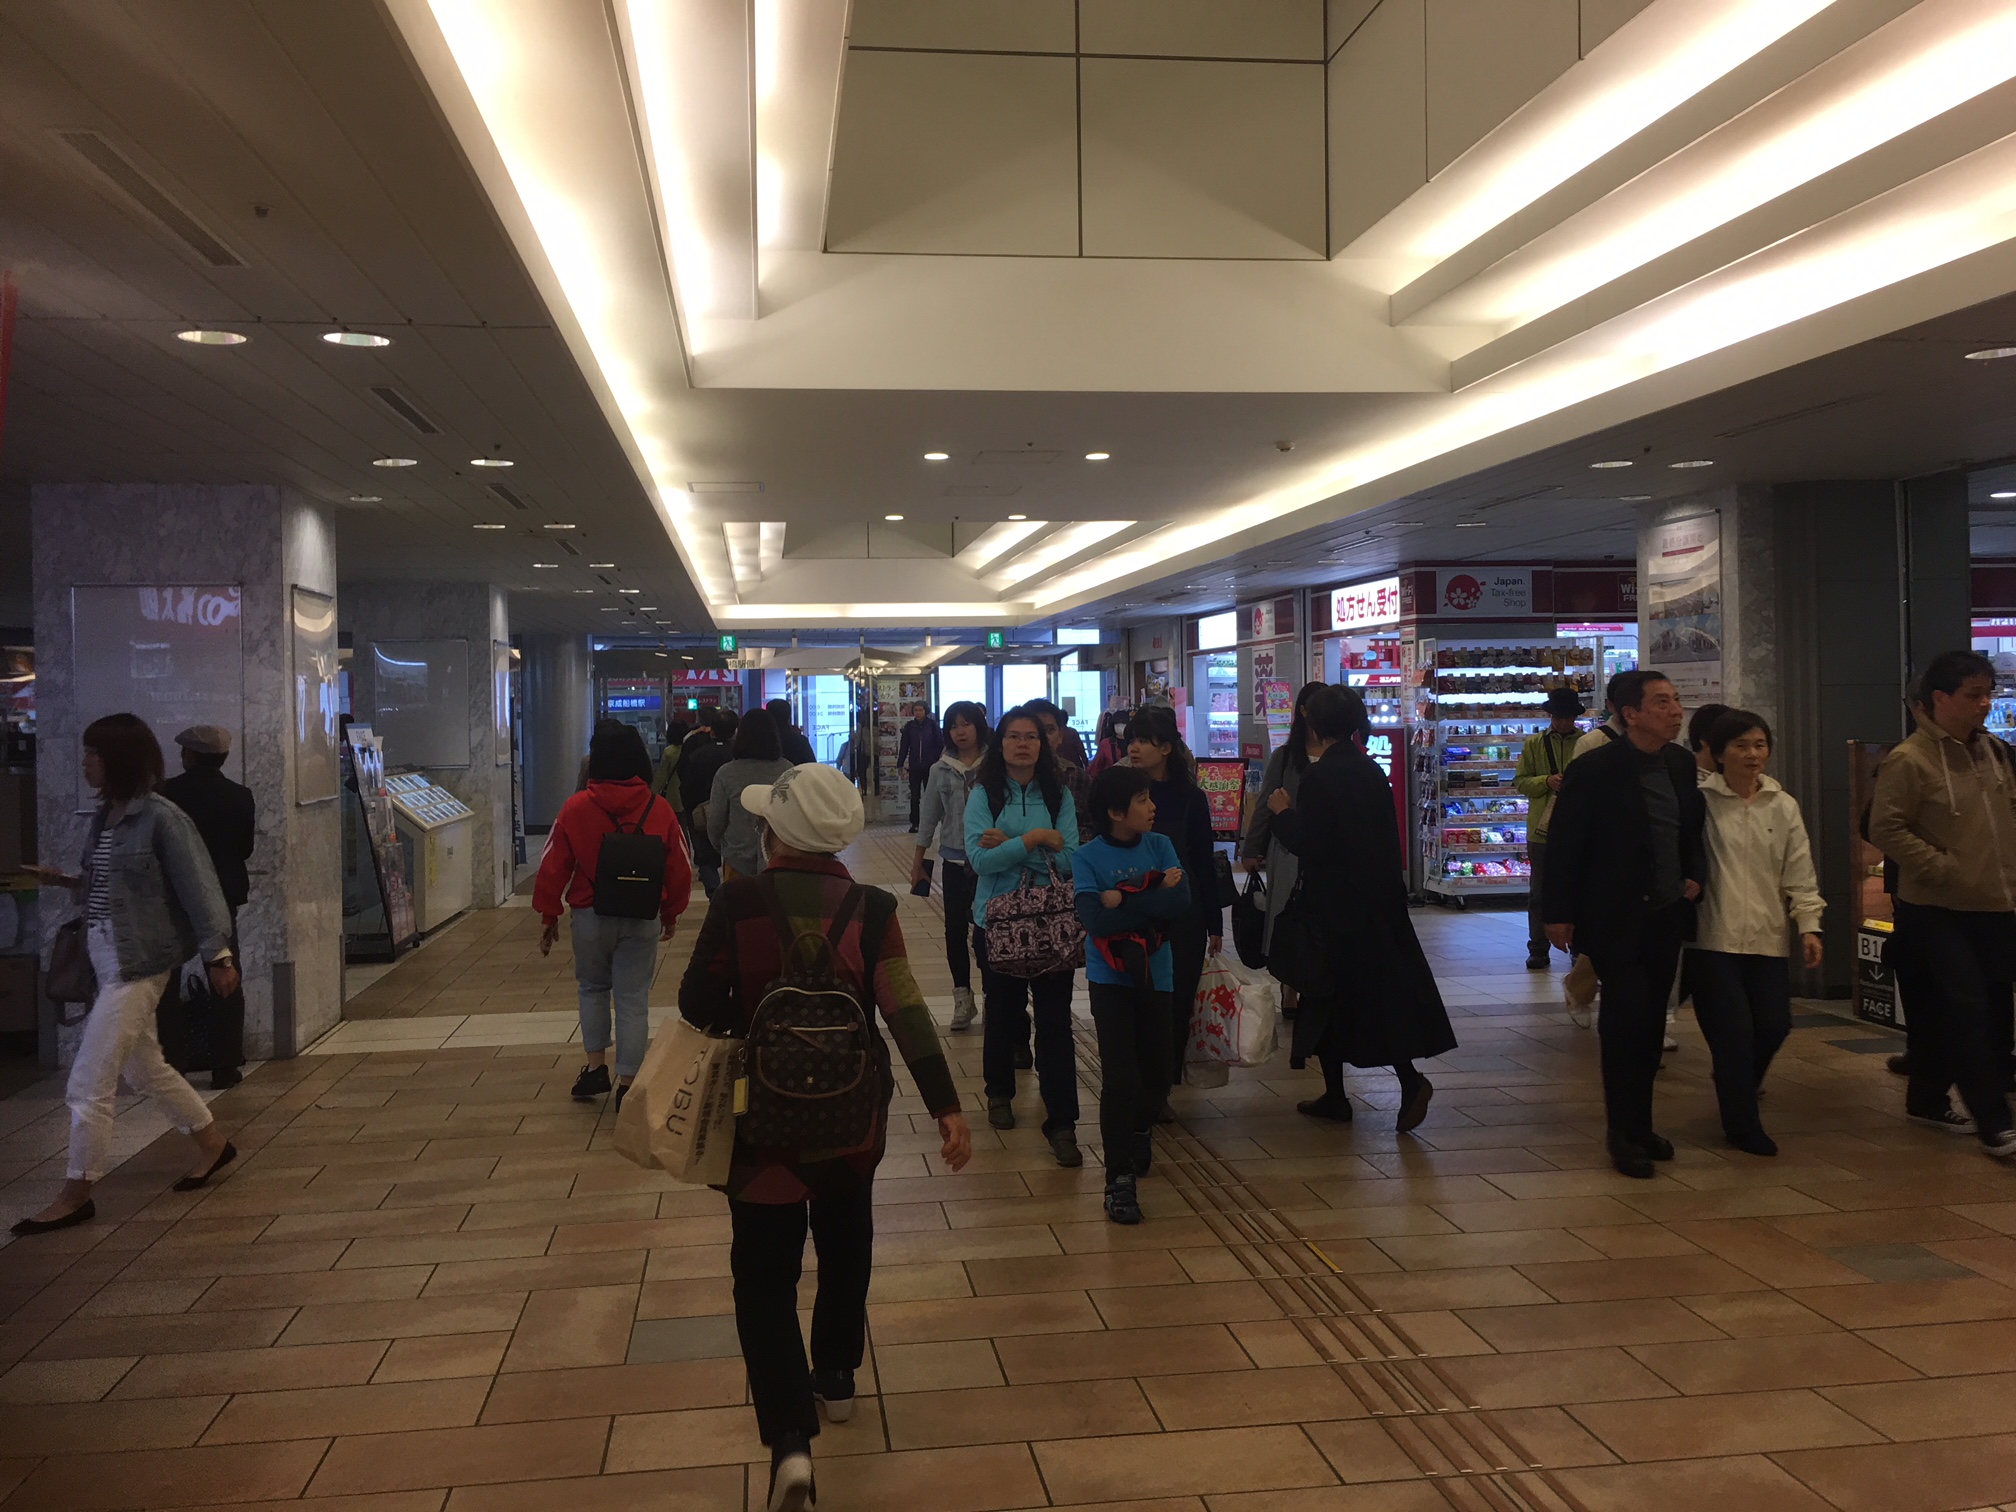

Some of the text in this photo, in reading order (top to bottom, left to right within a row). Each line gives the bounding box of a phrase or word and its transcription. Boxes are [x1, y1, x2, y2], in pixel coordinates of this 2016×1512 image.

[1491, 588, 1526, 597] Tax-free
[1623, 594, 1637, 602] FR
[1336, 585, 1398, 623] 処方せん受付
[1504, 598, 1526, 608] Shop
[608, 699, 646, 708] 京成船橋駅
[1199, 777, 1242, 792] 大感謝祭
[1861, 938, 1880, 959] B1
[1862, 998, 1892, 1018] FACE
